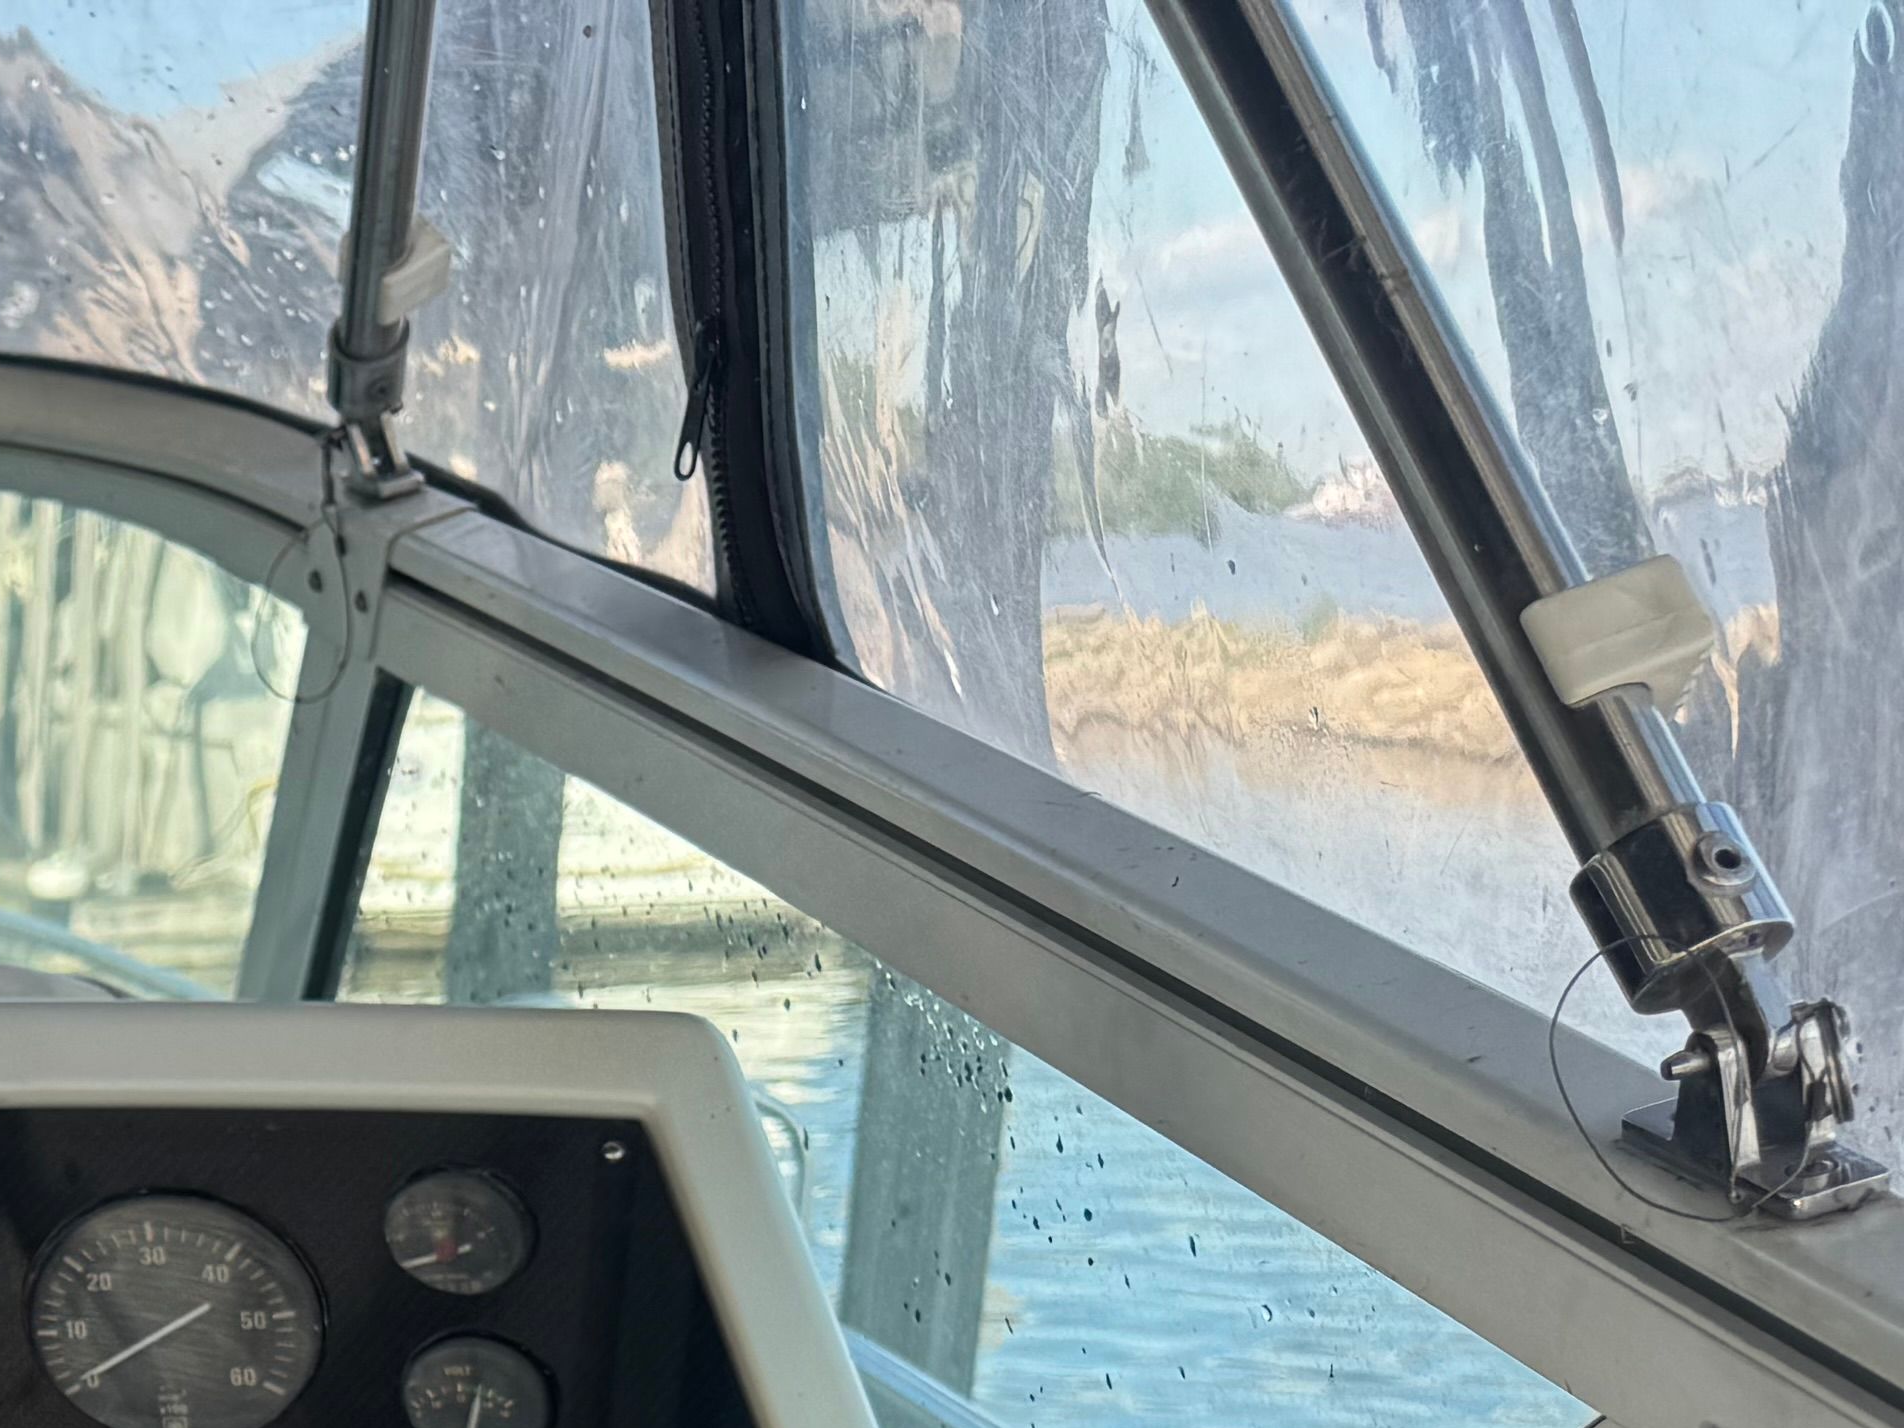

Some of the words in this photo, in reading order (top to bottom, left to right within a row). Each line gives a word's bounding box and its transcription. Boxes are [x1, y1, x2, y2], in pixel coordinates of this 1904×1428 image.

[139, 1246, 166, 1266] 30
[86, 1272, 112, 1292] 20
[201, 1264, 229, 1283] 40
[65, 1320, 88, 1339] 10
[240, 1311, 267, 1330] 50
[230, 1367, 257, 1386] 60
